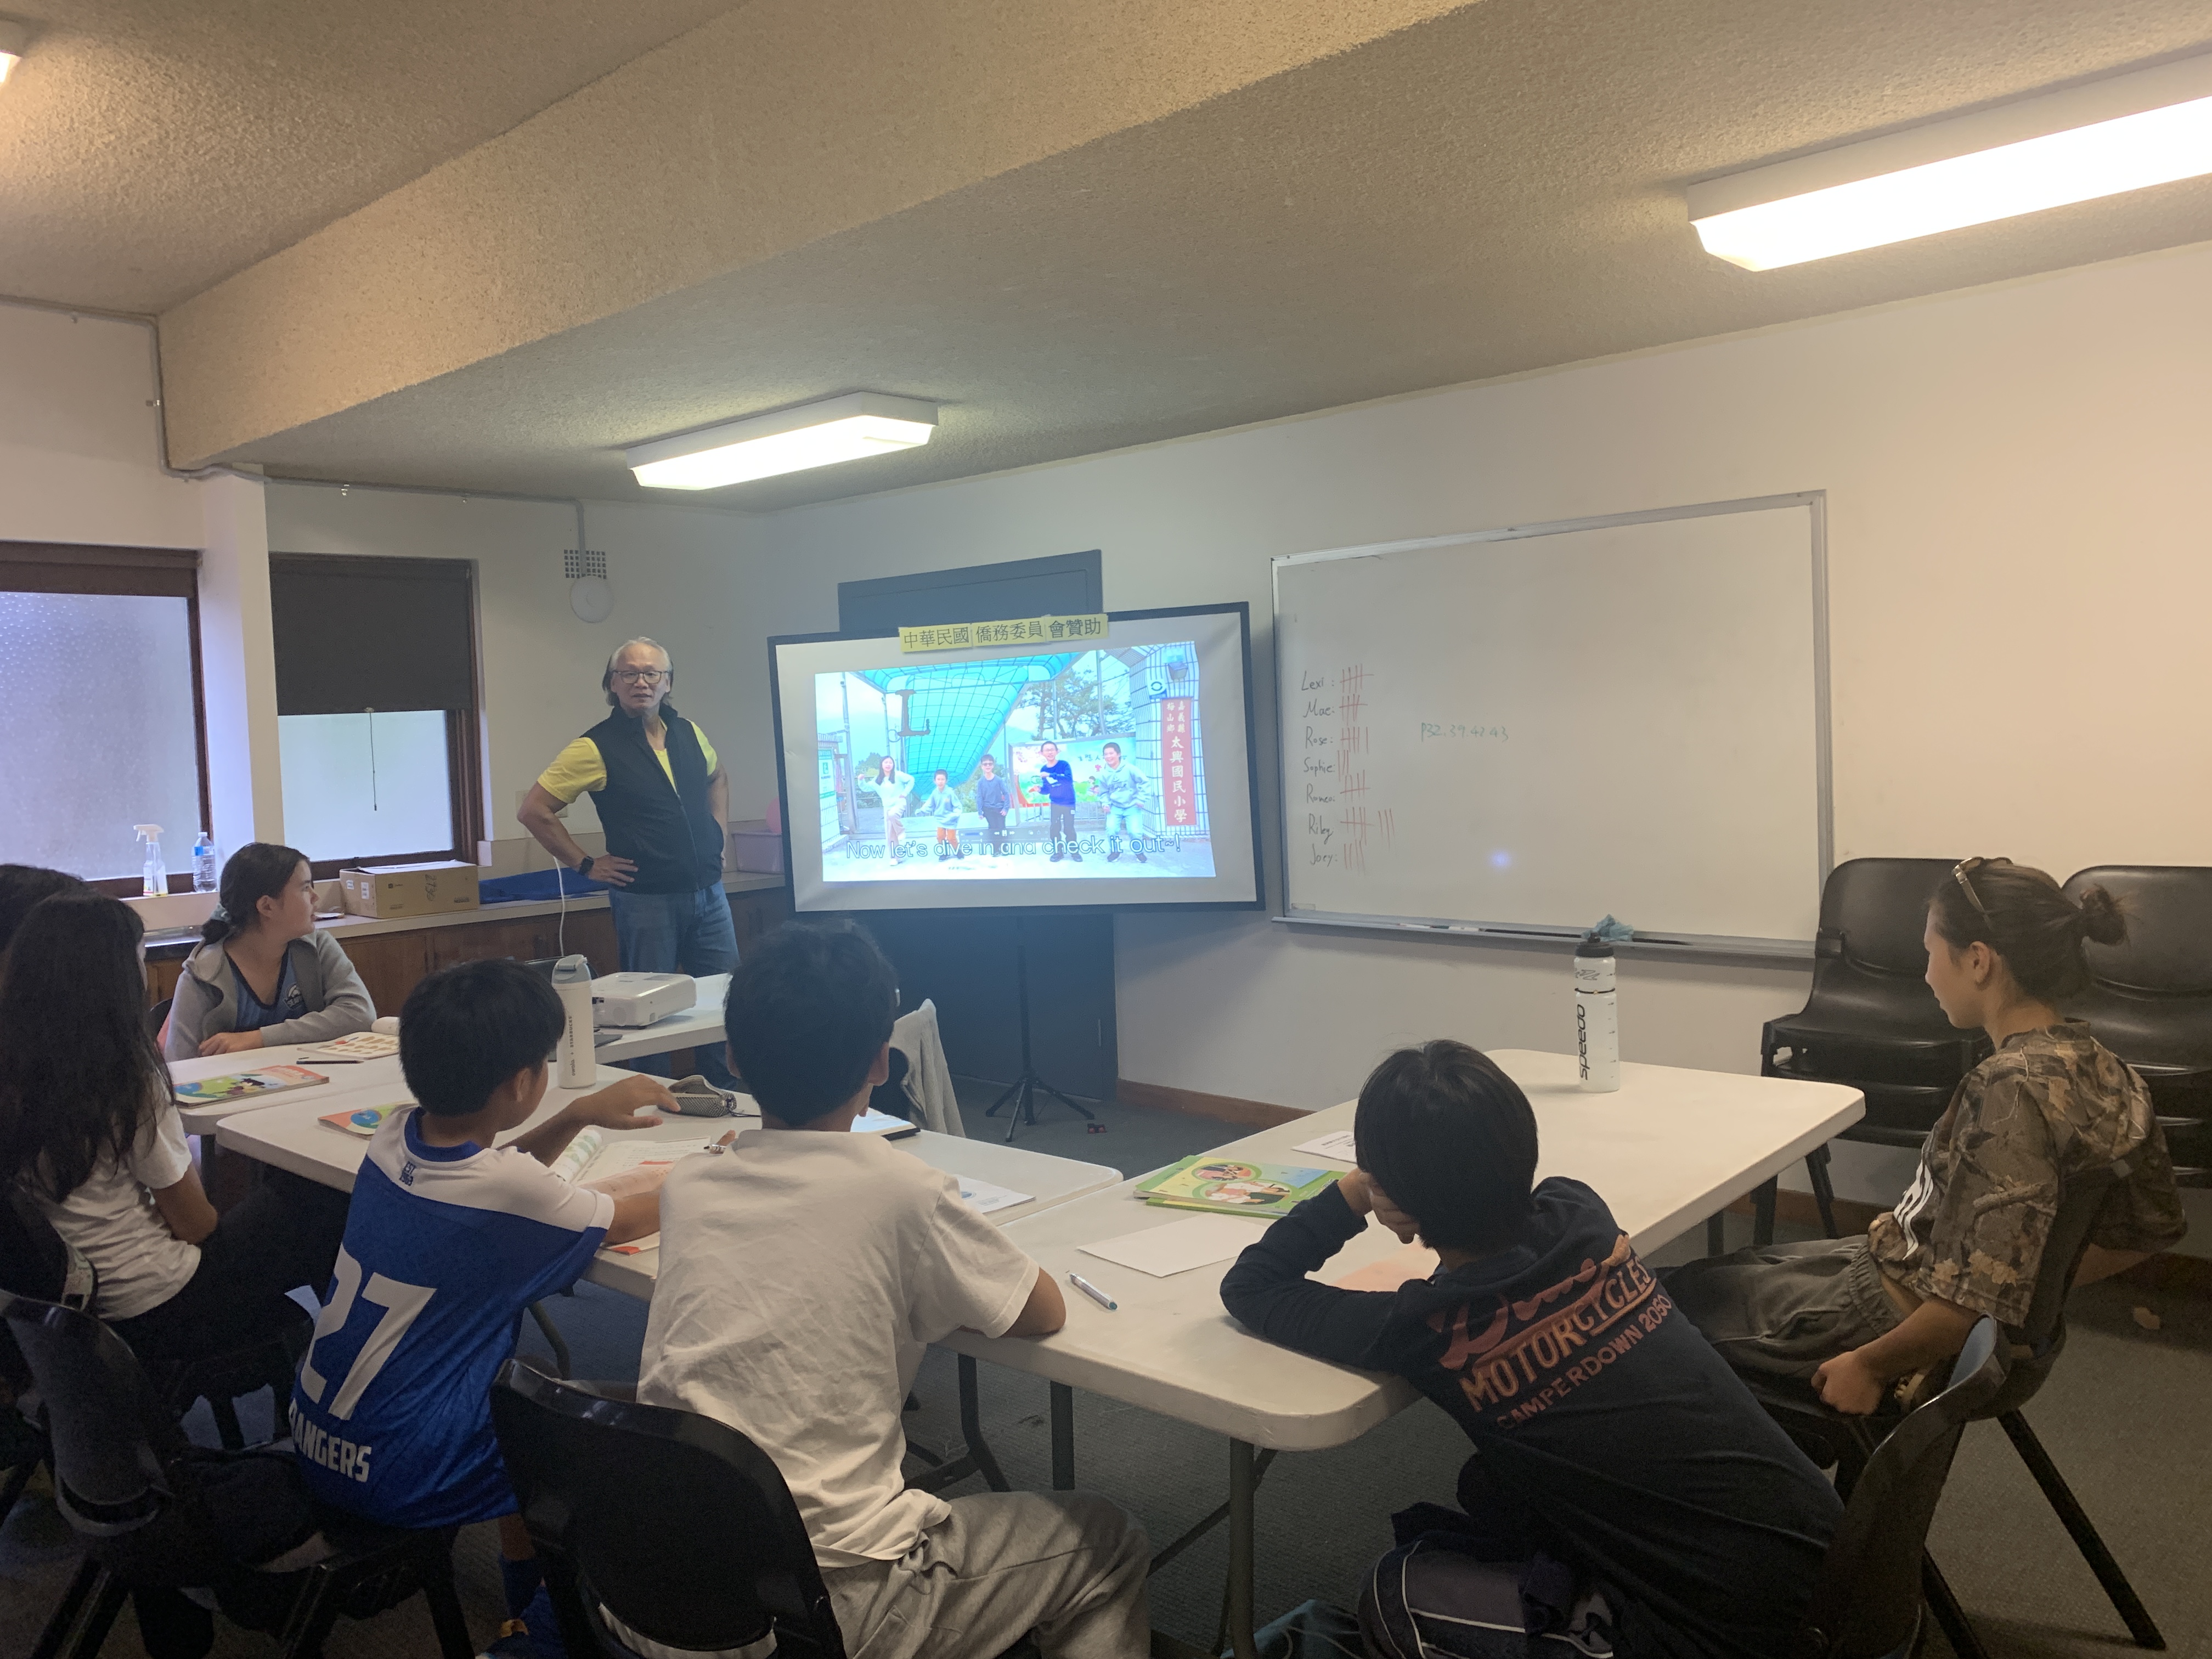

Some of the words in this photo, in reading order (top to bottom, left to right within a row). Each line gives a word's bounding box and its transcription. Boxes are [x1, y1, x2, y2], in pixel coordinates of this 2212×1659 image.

[1169, 735, 1187, 823] 太興國民小學
[847, 841, 885, 859] Now
[890, 840, 928, 858] let's
[934, 840, 973, 856] dive
[979, 843, 994, 855] in
[1042, 835, 1106, 854] check
[1109, 835, 1124, 853] it
[1577, 1003, 1590, 1080] speedo
[301, 1242, 437, 1421] 27
[1459, 1255, 1651, 1412] MOTORCYCLES
[1497, 1324, 1644, 1428] CAMPERDOWN
[1638, 1294, 1673, 1332] 2050
[288, 1397, 372, 1483] RANGERS
